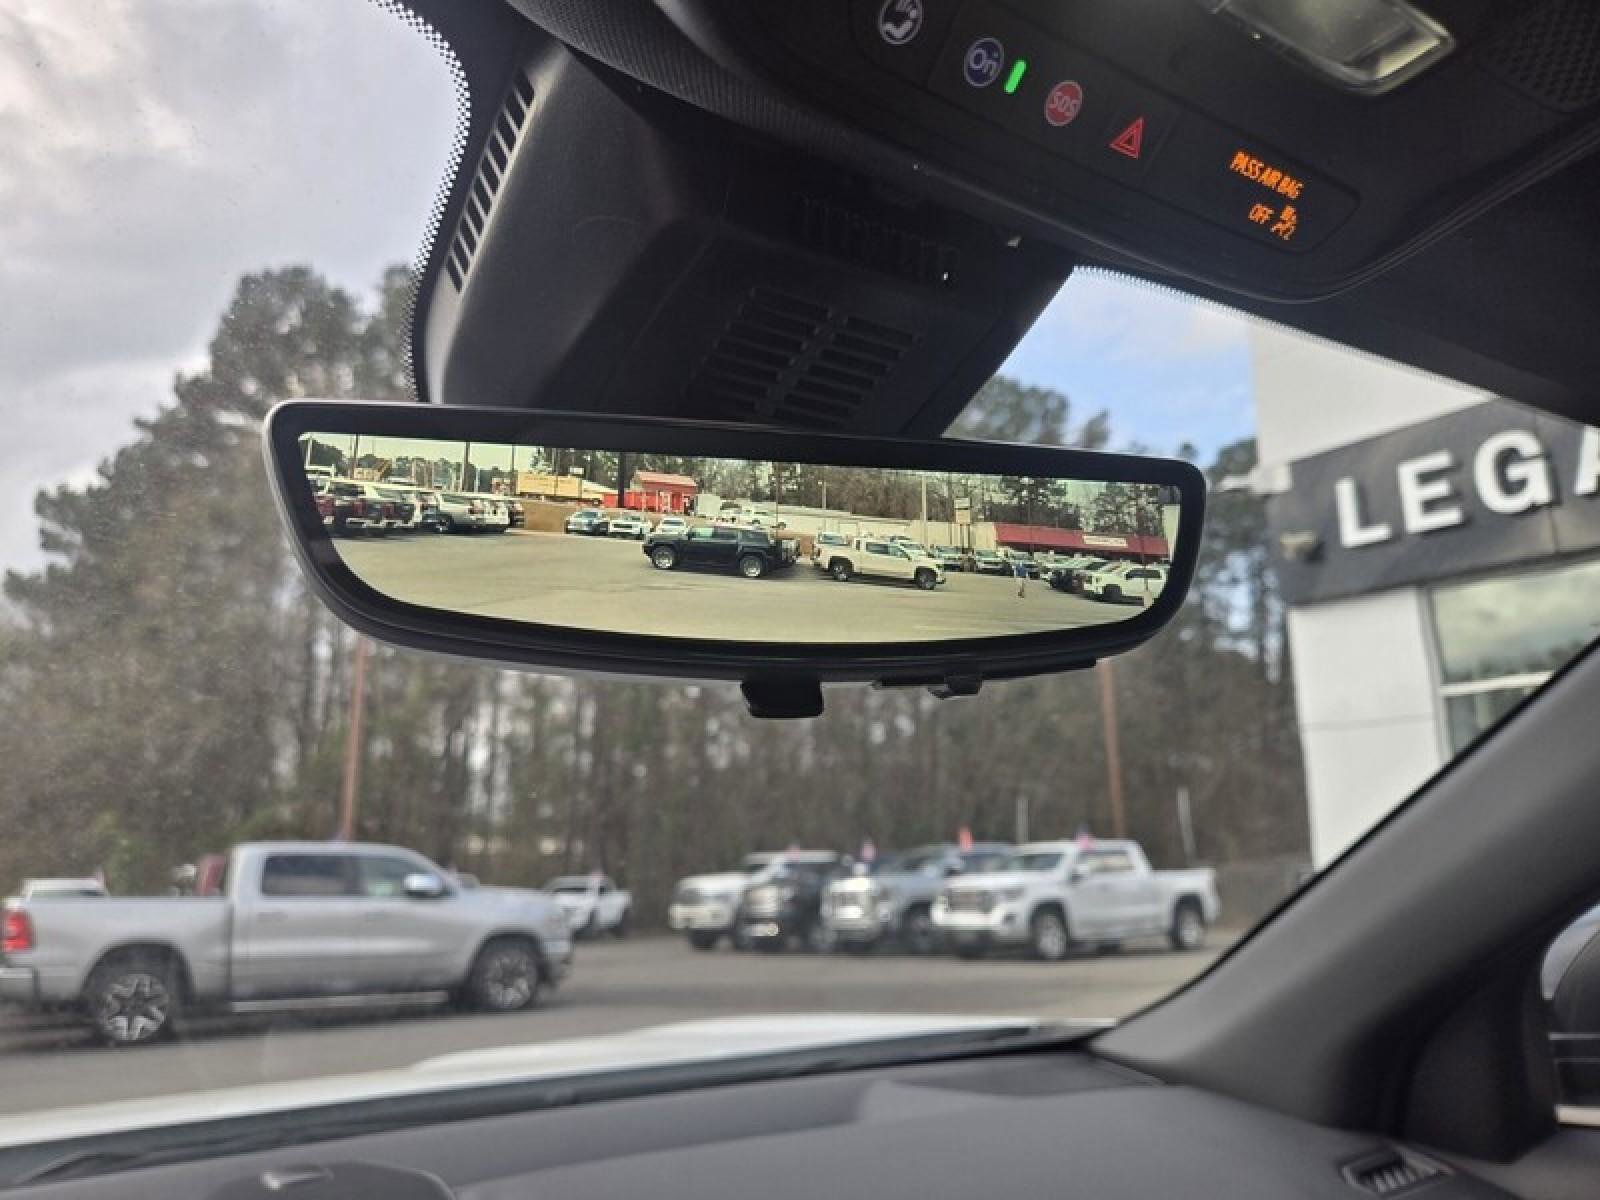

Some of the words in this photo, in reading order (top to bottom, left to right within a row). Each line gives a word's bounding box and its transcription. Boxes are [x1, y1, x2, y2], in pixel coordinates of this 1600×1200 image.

[1049, 91, 1080, 117] SOS
[1230, 152, 1264, 180] PASS
[1258, 167, 1282, 190] AIR
[1278, 176, 1303, 199] BAG
[1249, 204, 1275, 224] OFF
